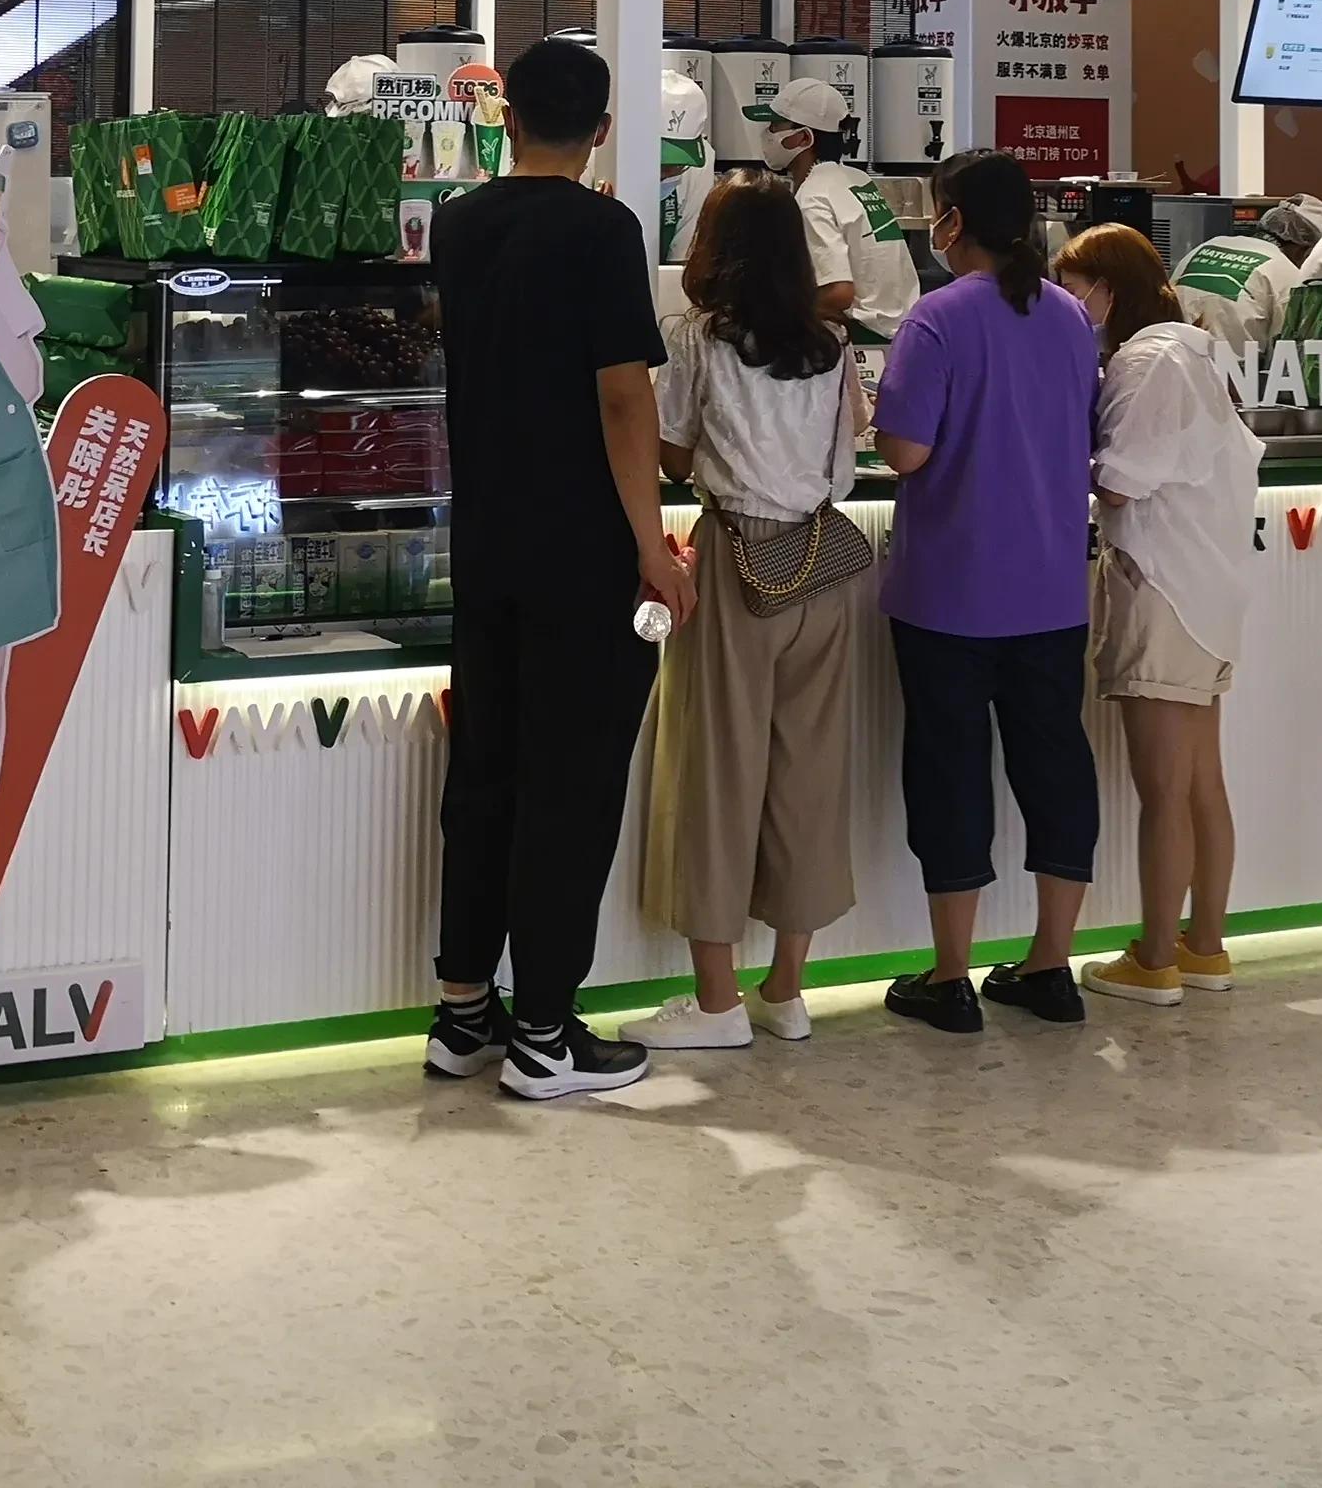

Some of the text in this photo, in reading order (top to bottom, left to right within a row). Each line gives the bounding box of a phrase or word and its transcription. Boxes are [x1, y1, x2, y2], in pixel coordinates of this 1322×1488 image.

[996, 30, 1110, 51] 火爆北京的炒菜馆
[996, 61, 1110, 82] 服务不满意 免单
[376, 76, 433, 97] 热门榜
[1023, 124, 1081, 140] 北京通州区
[1064, 147, 1089, 161] TOP
[56, 405, 118, 509] 关晓彤
[82, 418, 151, 558] 天然呆店长
